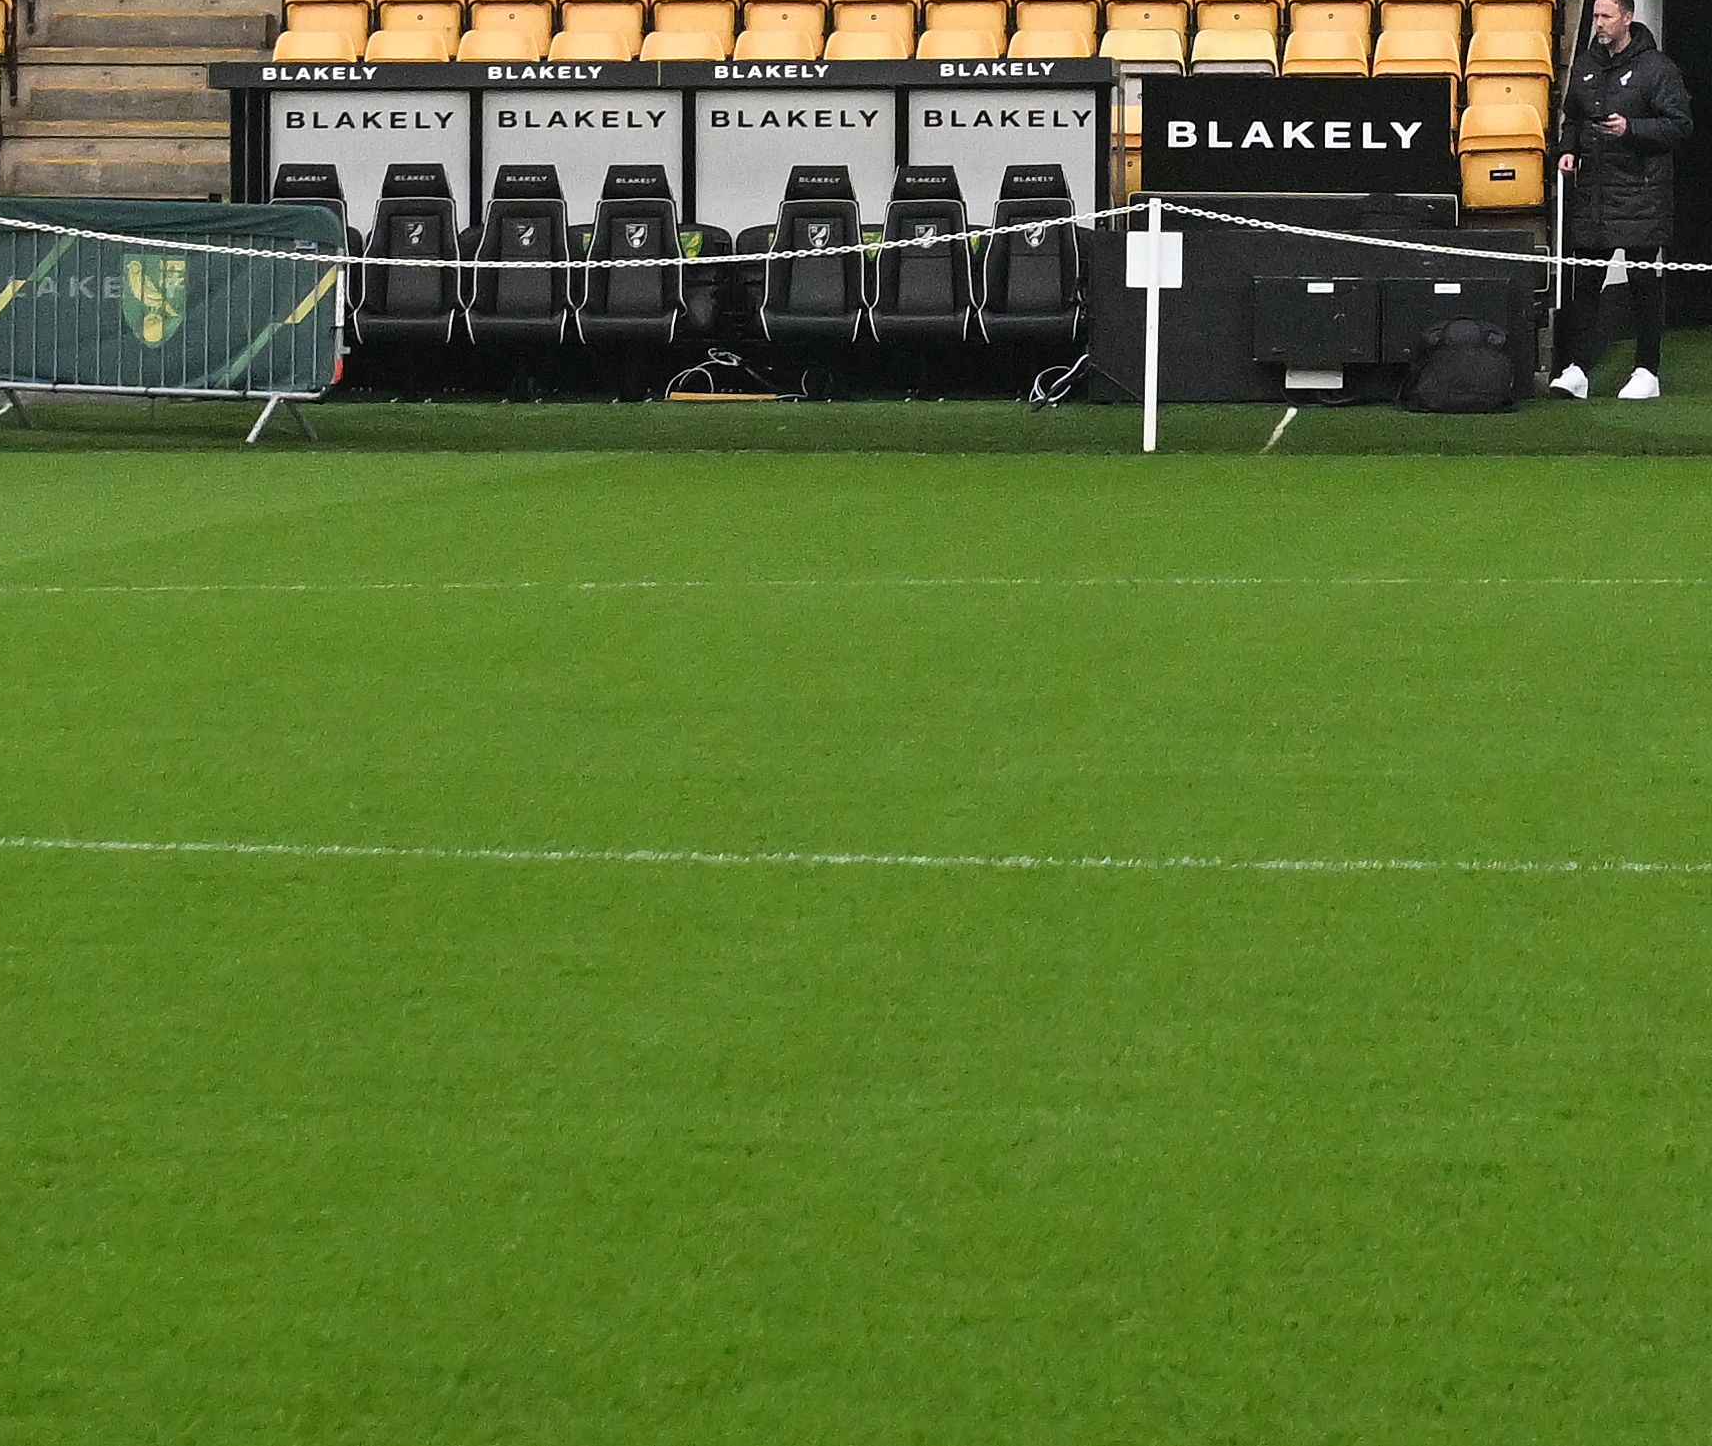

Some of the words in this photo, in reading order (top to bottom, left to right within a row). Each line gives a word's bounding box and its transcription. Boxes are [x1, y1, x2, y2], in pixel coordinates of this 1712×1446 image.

[262, 66, 378, 81] BLAKELY
[487, 65, 603, 80] BLAKELY
[713, 64, 830, 79] BLAKELY
[939, 62, 1055, 77] BLAKELY
[286, 111, 454, 129] BLAKELY
[498, 110, 666, 128] BLAKELY
[711, 110, 878, 128] BLAKELY
[924, 109, 1091, 128] BLAKELY
[1167, 120, 1422, 149] BLAKELY
[285, 175, 328, 183] BLAKELY
[798, 176, 840, 184] BLAKELY
